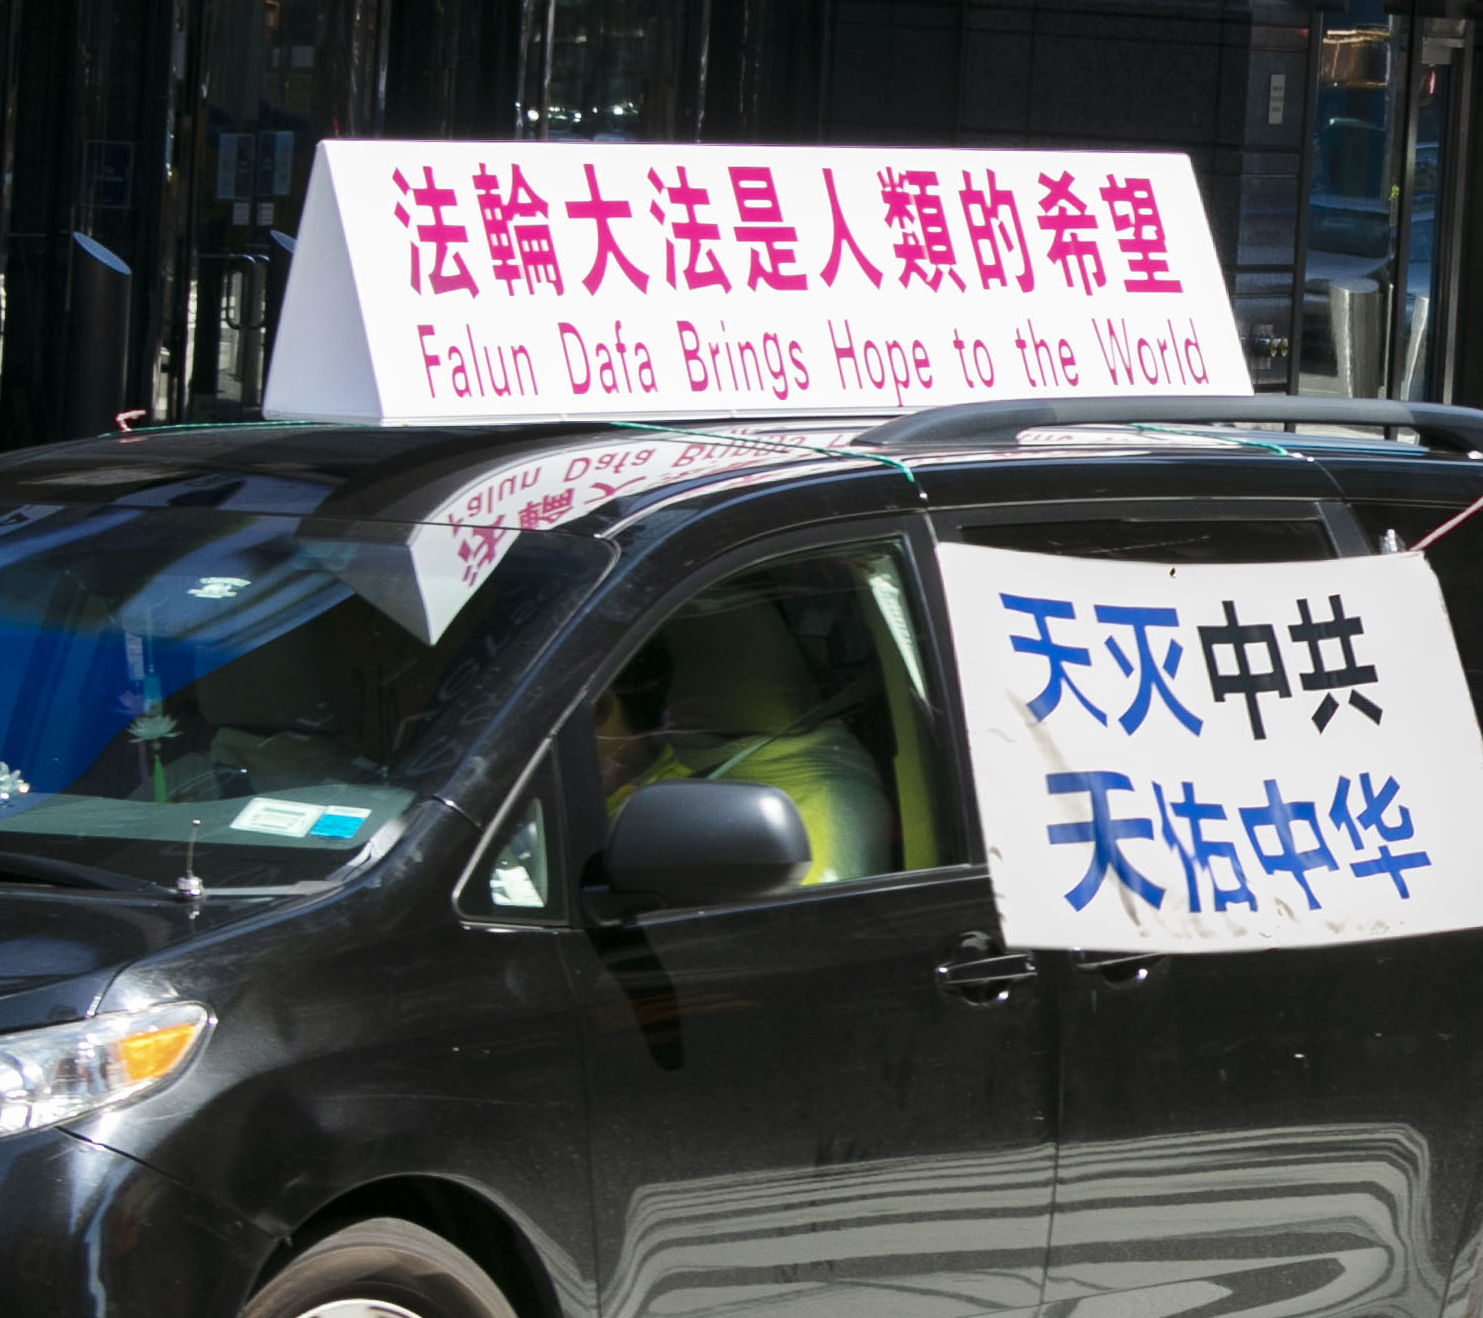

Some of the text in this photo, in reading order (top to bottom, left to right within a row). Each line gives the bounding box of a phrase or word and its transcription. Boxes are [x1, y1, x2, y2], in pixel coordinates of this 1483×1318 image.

[392, 162, 1184, 297] 法輪大法是人類的希望
[417, 316, 1209, 407] Falun Dafa Brings Hope to the World
[998, 592, 1385, 740] 天灭中共
[1045, 769, 1433, 913] 天佑中华
